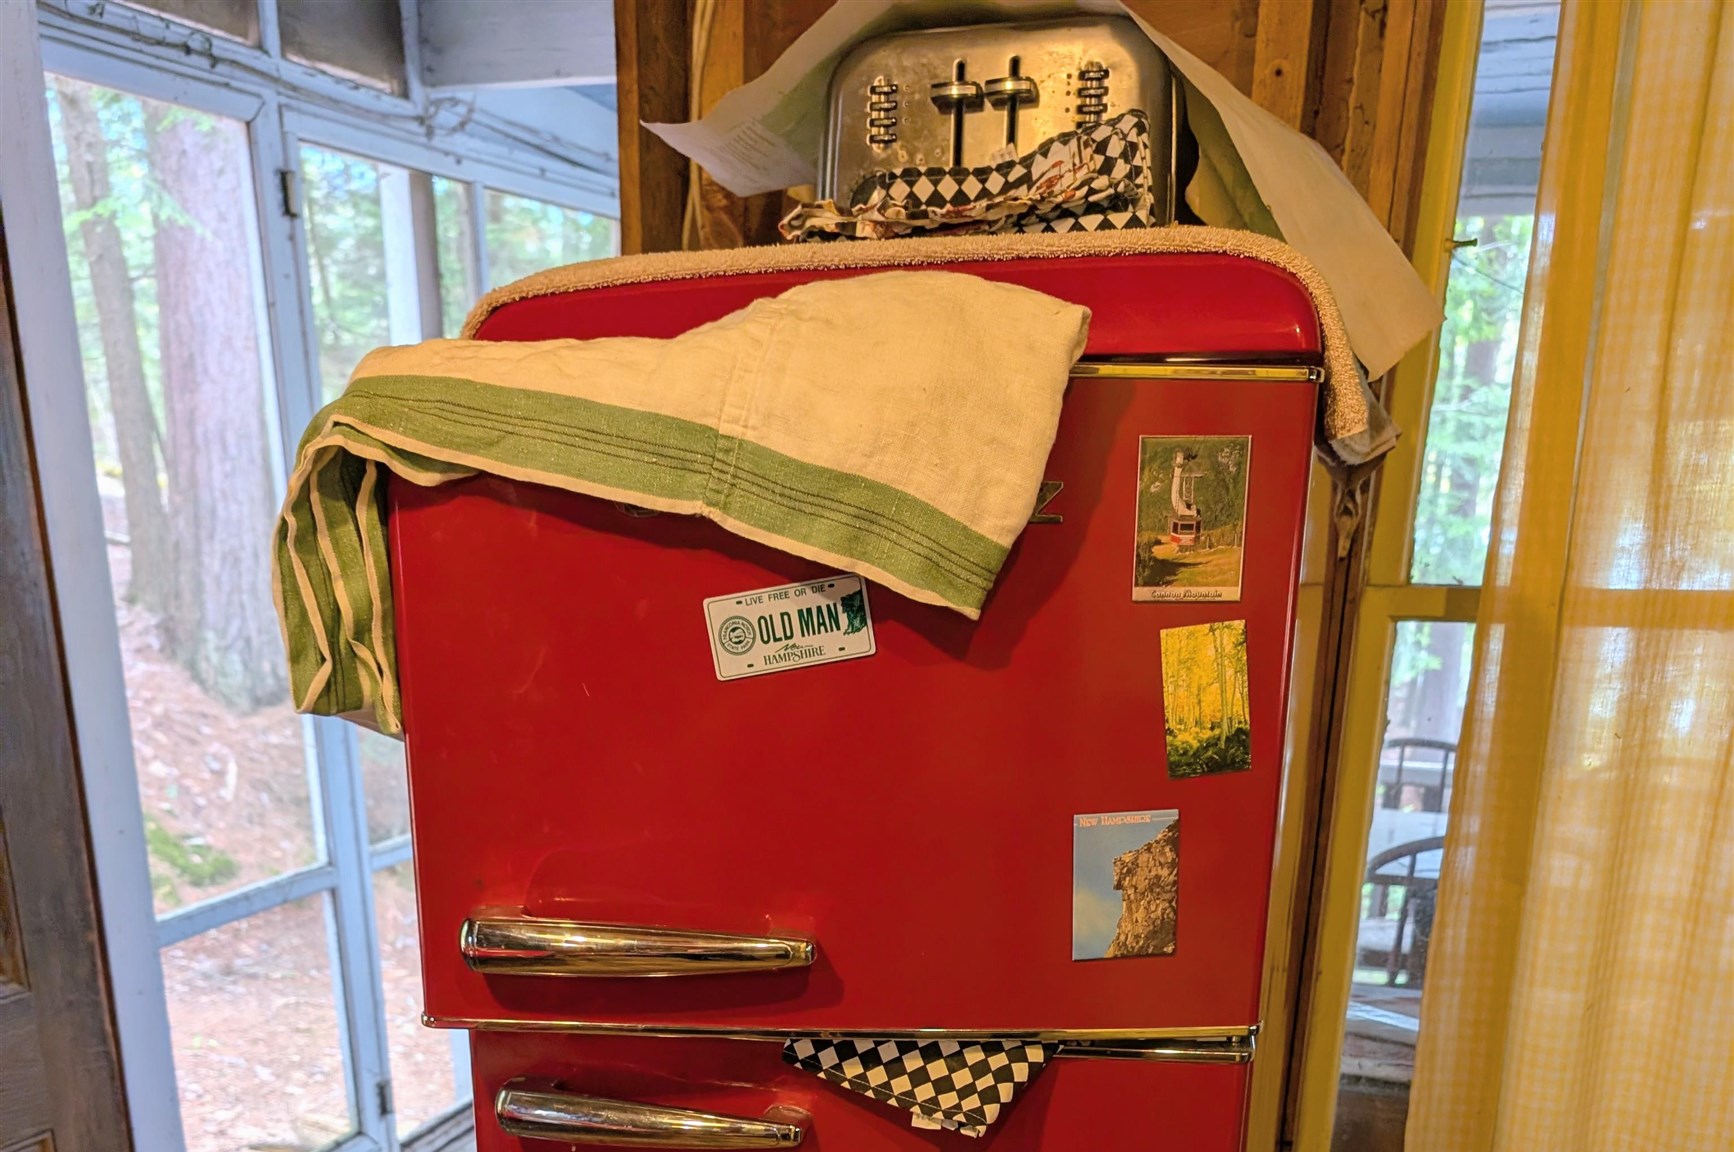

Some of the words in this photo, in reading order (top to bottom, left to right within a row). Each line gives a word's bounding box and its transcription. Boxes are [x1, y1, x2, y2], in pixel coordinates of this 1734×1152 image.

[745, 596, 764, 606] LIVE
[768, 590, 790, 601] FREE
[794, 587, 807, 597] OR
[811, 584, 826, 594] DIE
[1151, 590, 1180, 599] Cannon
[757, 612, 794, 645] OLD
[797, 603, 841, 638] MAN
[763, 645, 826, 666] HAMPSHIRE
